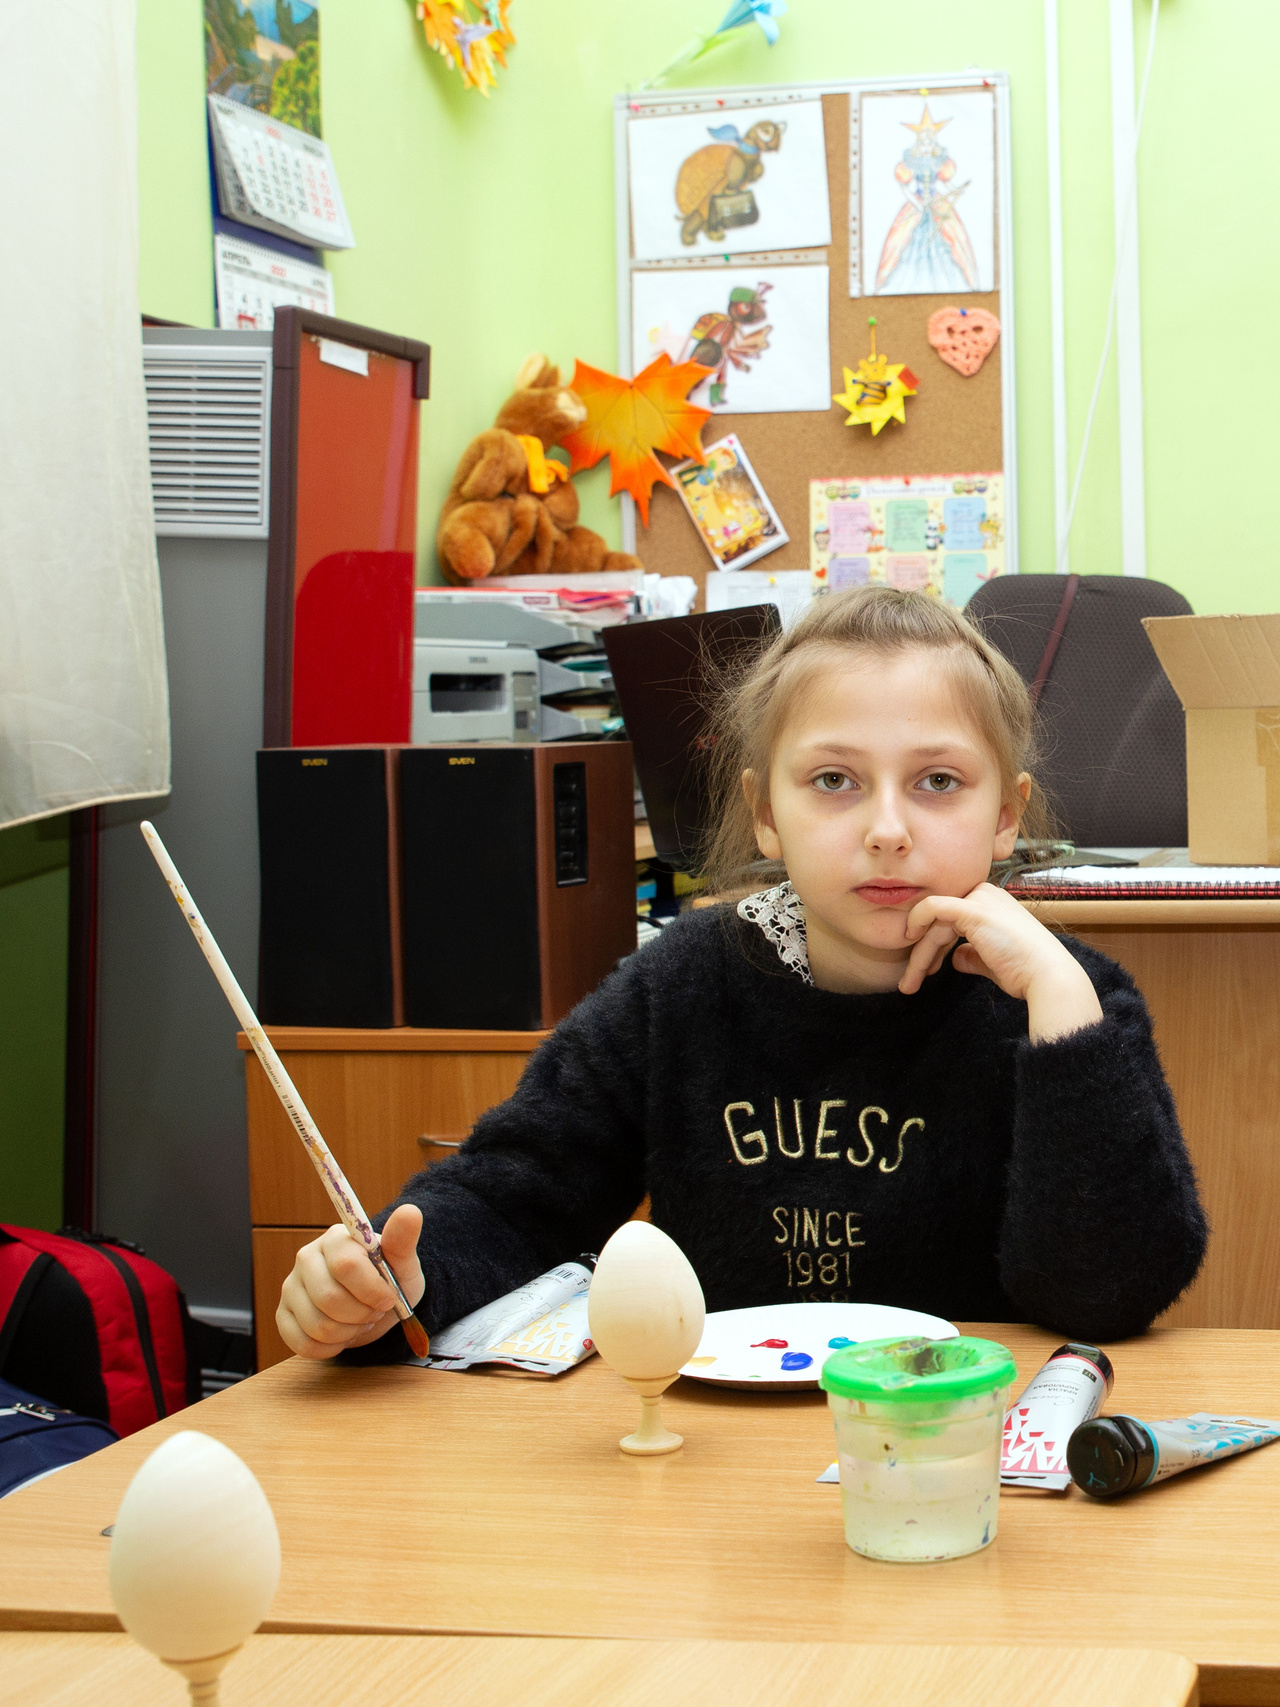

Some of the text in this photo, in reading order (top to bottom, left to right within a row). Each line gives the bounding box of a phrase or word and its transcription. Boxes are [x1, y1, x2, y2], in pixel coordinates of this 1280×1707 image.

[302, 758, 328, 766] SVEN
[448, 757, 476, 766] SVEN
[723, 1096, 926, 1174] GUESS
[772, 1206, 866, 1248] SINCE
[782, 1251, 853, 1287] 1981
